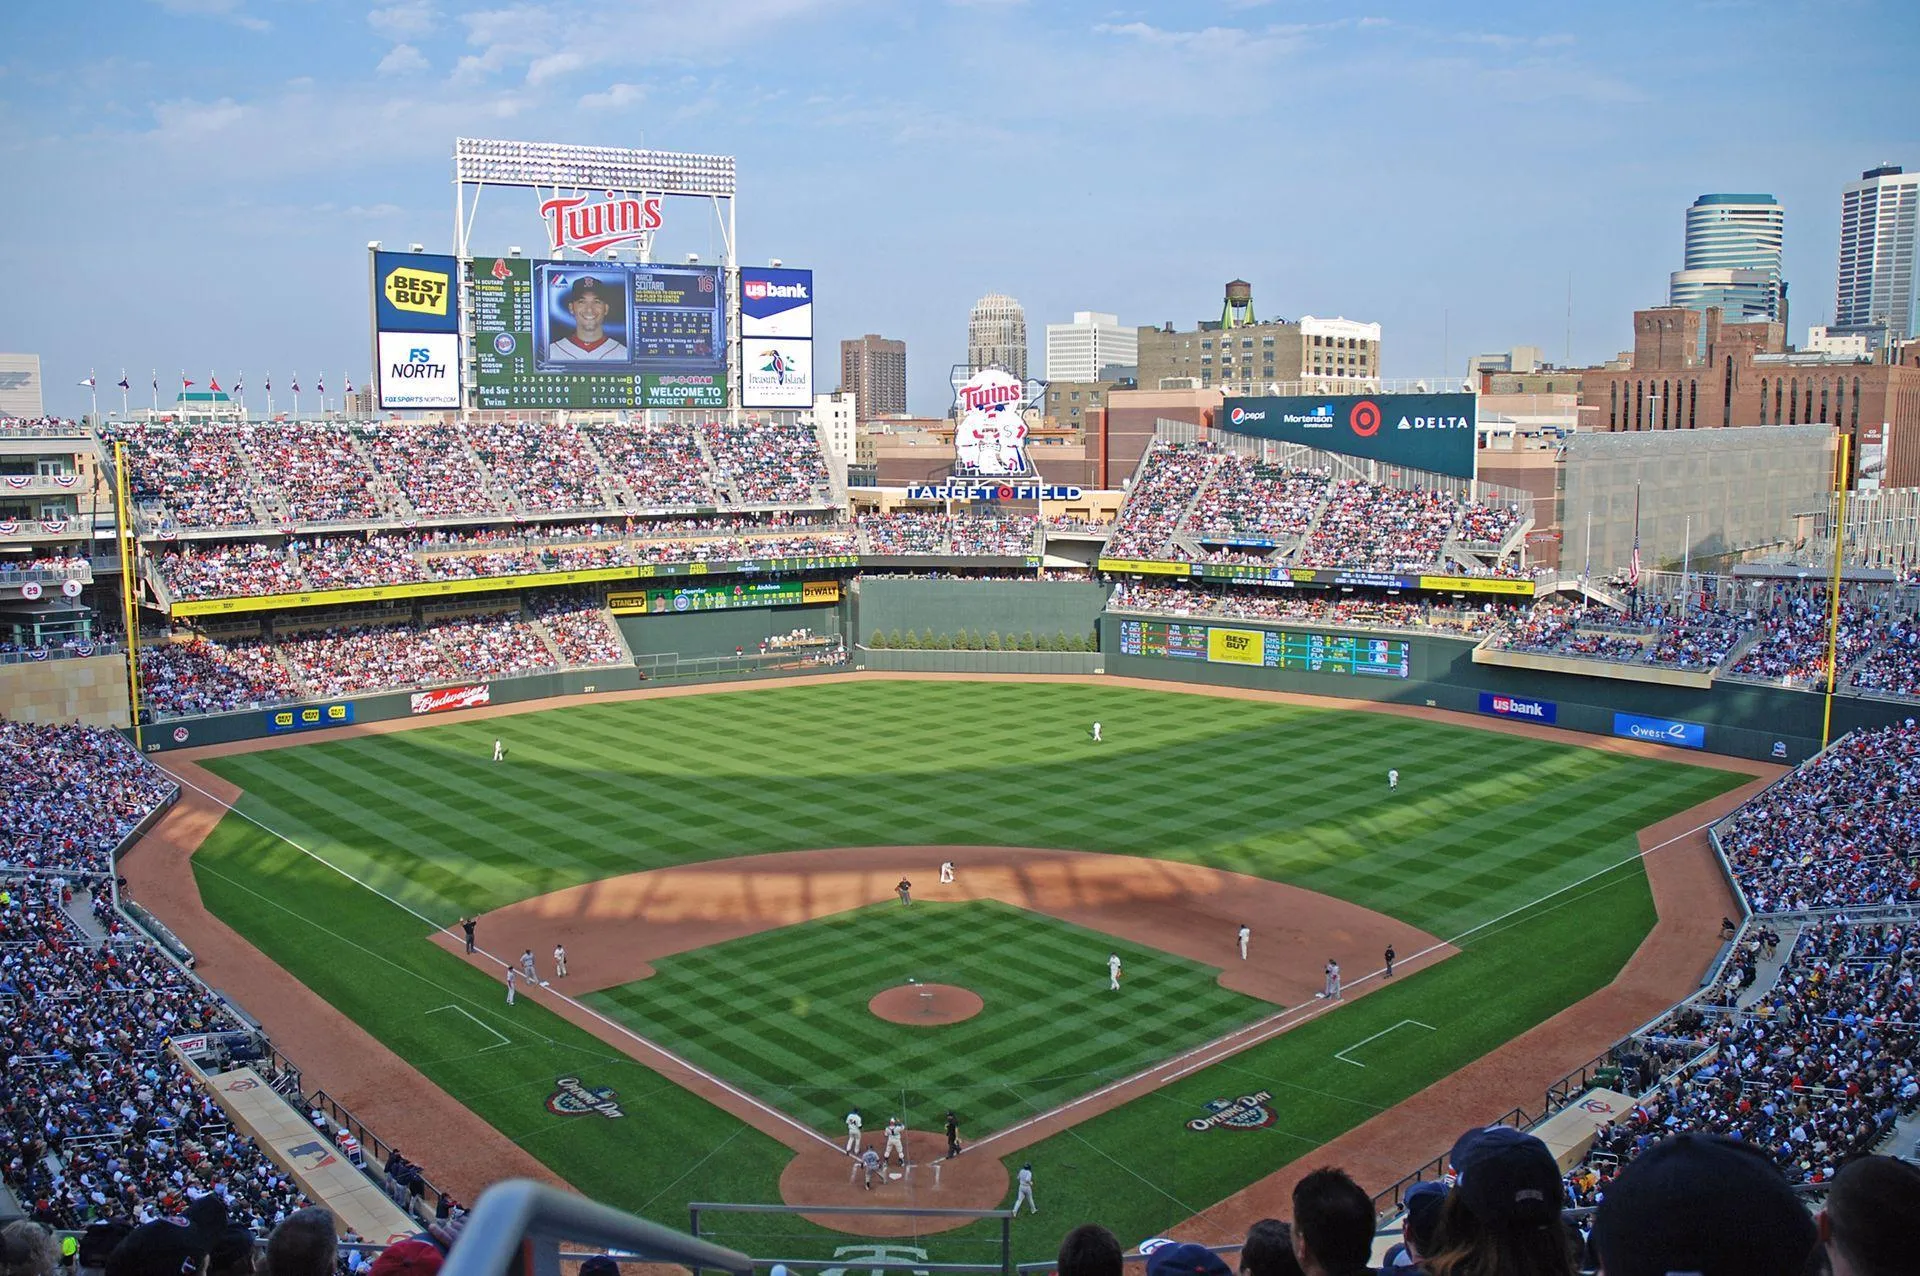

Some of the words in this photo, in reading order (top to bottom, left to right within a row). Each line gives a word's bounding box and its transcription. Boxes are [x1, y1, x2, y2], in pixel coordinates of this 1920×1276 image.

[540, 190, 662, 251] Twins
[394, 275, 446, 294] BEST
[636, 282, 664, 290] SCUTARO
[698, 276, 714, 292] 16
[746, 282, 809, 298] usbank
[396, 290, 441, 307] BUY
[410, 348, 430, 362] FS
[392, 364, 445, 378] NORTH
[749, 372, 777, 384] Treasure
[785, 373, 806, 384] Island
[635, 375, 641, 383] 0
[480, 386, 494, 394] Red
[496, 386, 509, 394] Sox
[635, 386, 641, 395] 0
[650, 387, 703, 396] WELCOME
[707, 388, 721, 397] TO
[635, 397, 641, 405] 0
[960, 383, 1020, 412] Twins
[1245, 410, 1264, 422] pepsi
[1284, 414, 1332, 423] Mortenson
[1414, 416, 1467, 428] DELTA
[907, 486, 994, 500] TARGET
[1017, 487, 1082, 500] FIELD
[611, 598, 644, 607] STANLEY
[1226, 635, 1250, 645] BEST
[1226, 642, 1247, 650] BUY
[419, 684, 488, 712] Budweiser
[1493, 699, 1543, 716] usbank
[1631, 724, 1665, 739] Qwest
[558, 1078, 601, 1104] OPENING
[594, 1102, 624, 1118] DAY
[1187, 1104, 1245, 1130] OPENING
[1237, 1091, 1272, 1106] DAY
